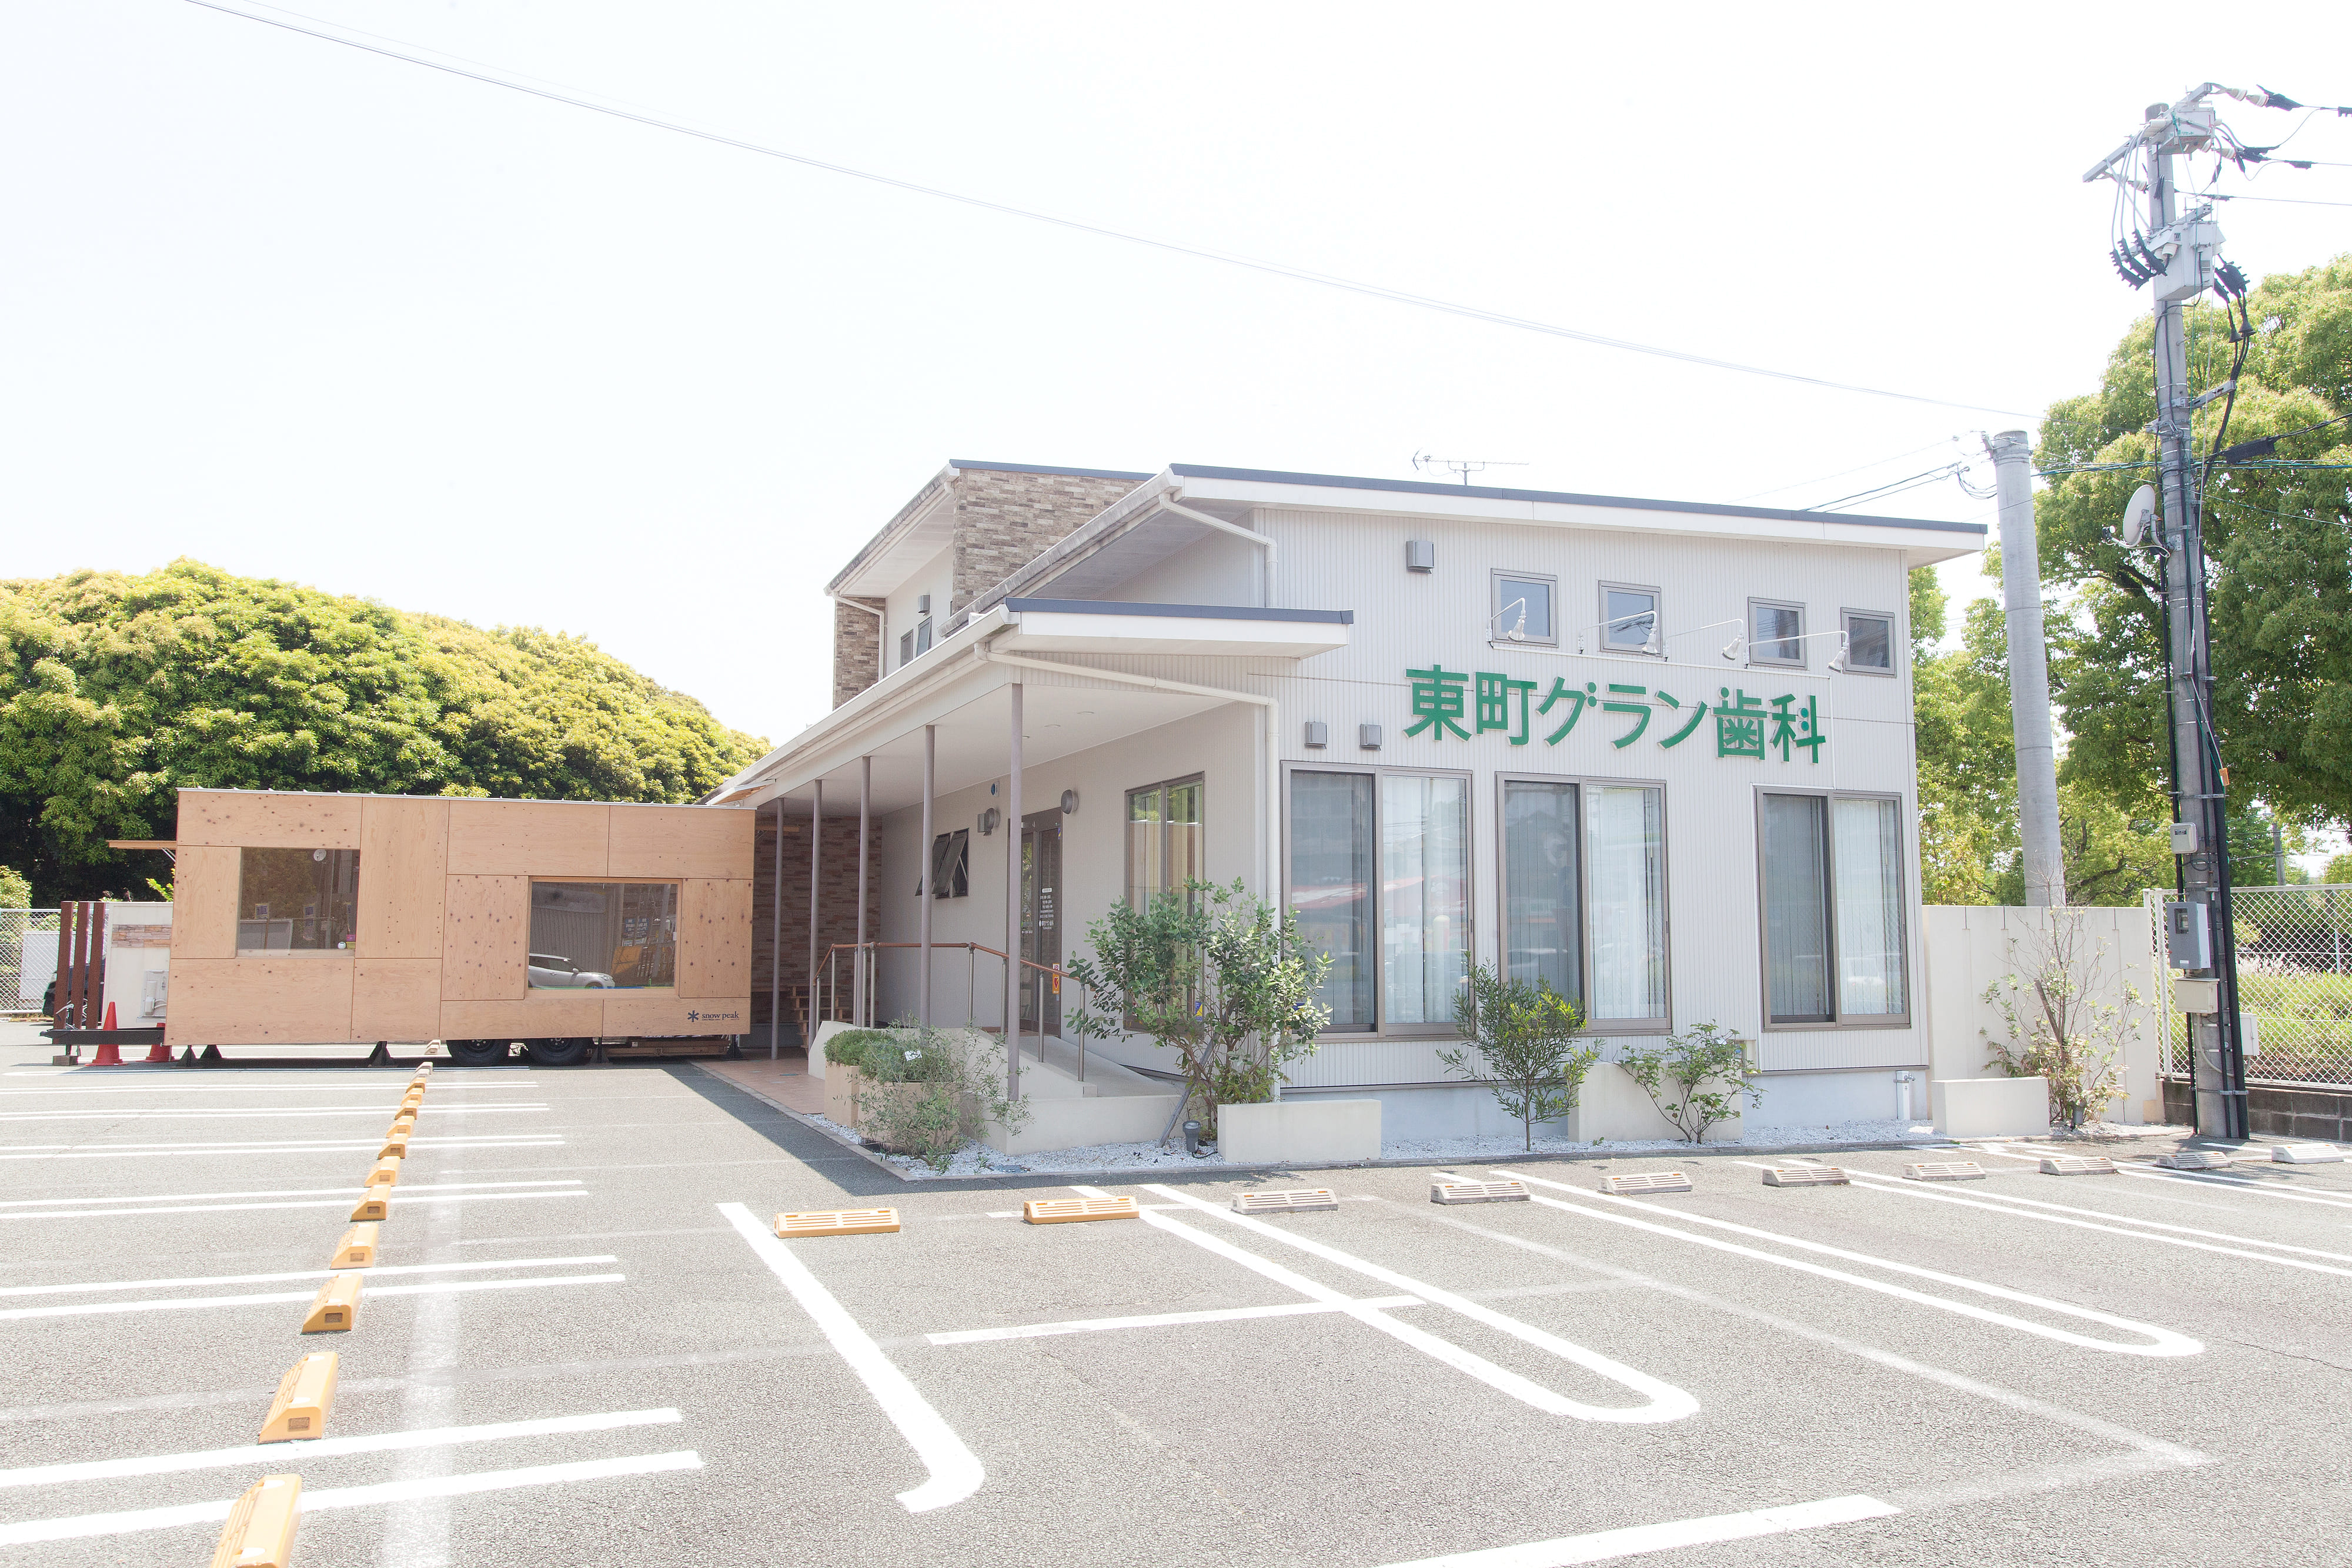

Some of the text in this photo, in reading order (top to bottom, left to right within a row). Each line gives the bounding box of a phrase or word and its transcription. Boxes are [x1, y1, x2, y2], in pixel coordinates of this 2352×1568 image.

[1403, 664, 1826, 764] 東町グラン歯科
[721, 1011, 739, 1020] peak
